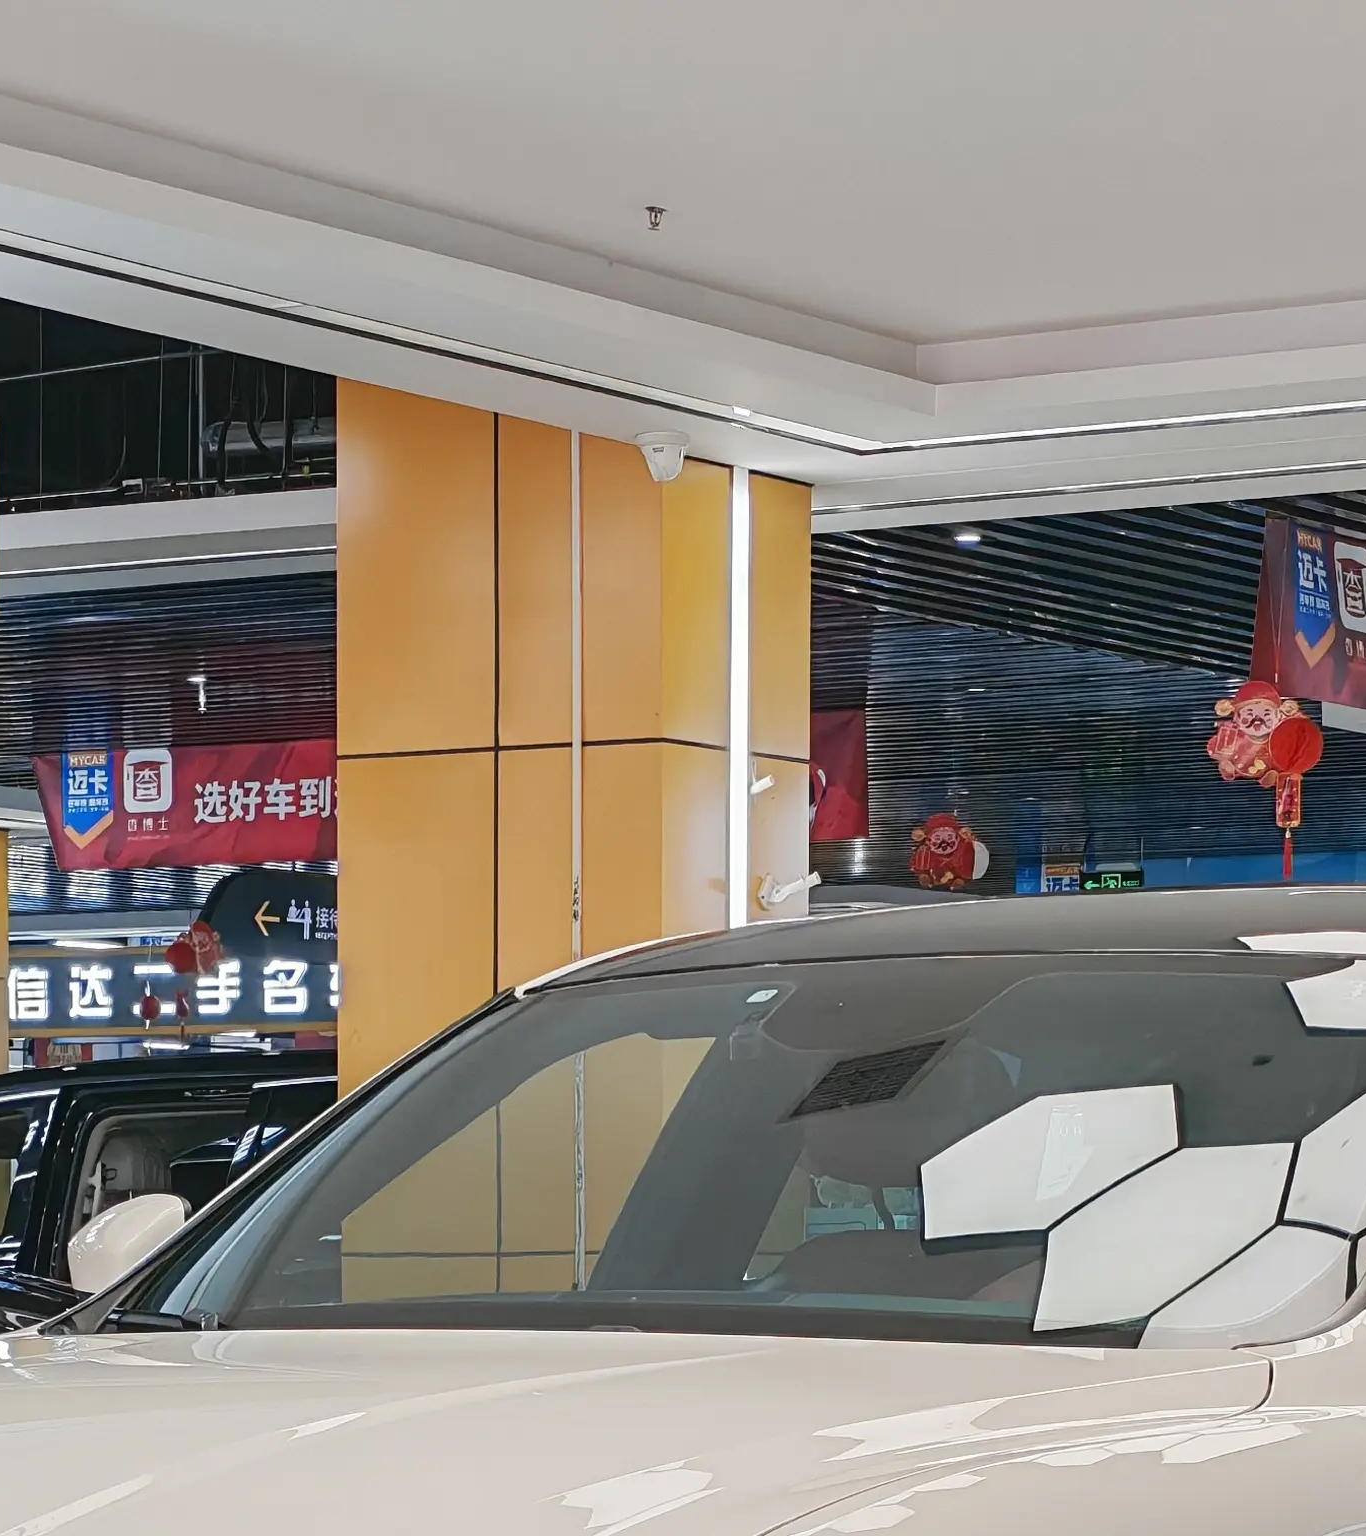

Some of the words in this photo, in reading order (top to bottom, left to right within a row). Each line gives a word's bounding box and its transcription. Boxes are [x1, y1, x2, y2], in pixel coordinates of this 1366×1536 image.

[68, 768, 109, 795] 迈卡
[193, 775, 337, 824] 选好车到
[8, 958, 338, 1021] 信达二手名
